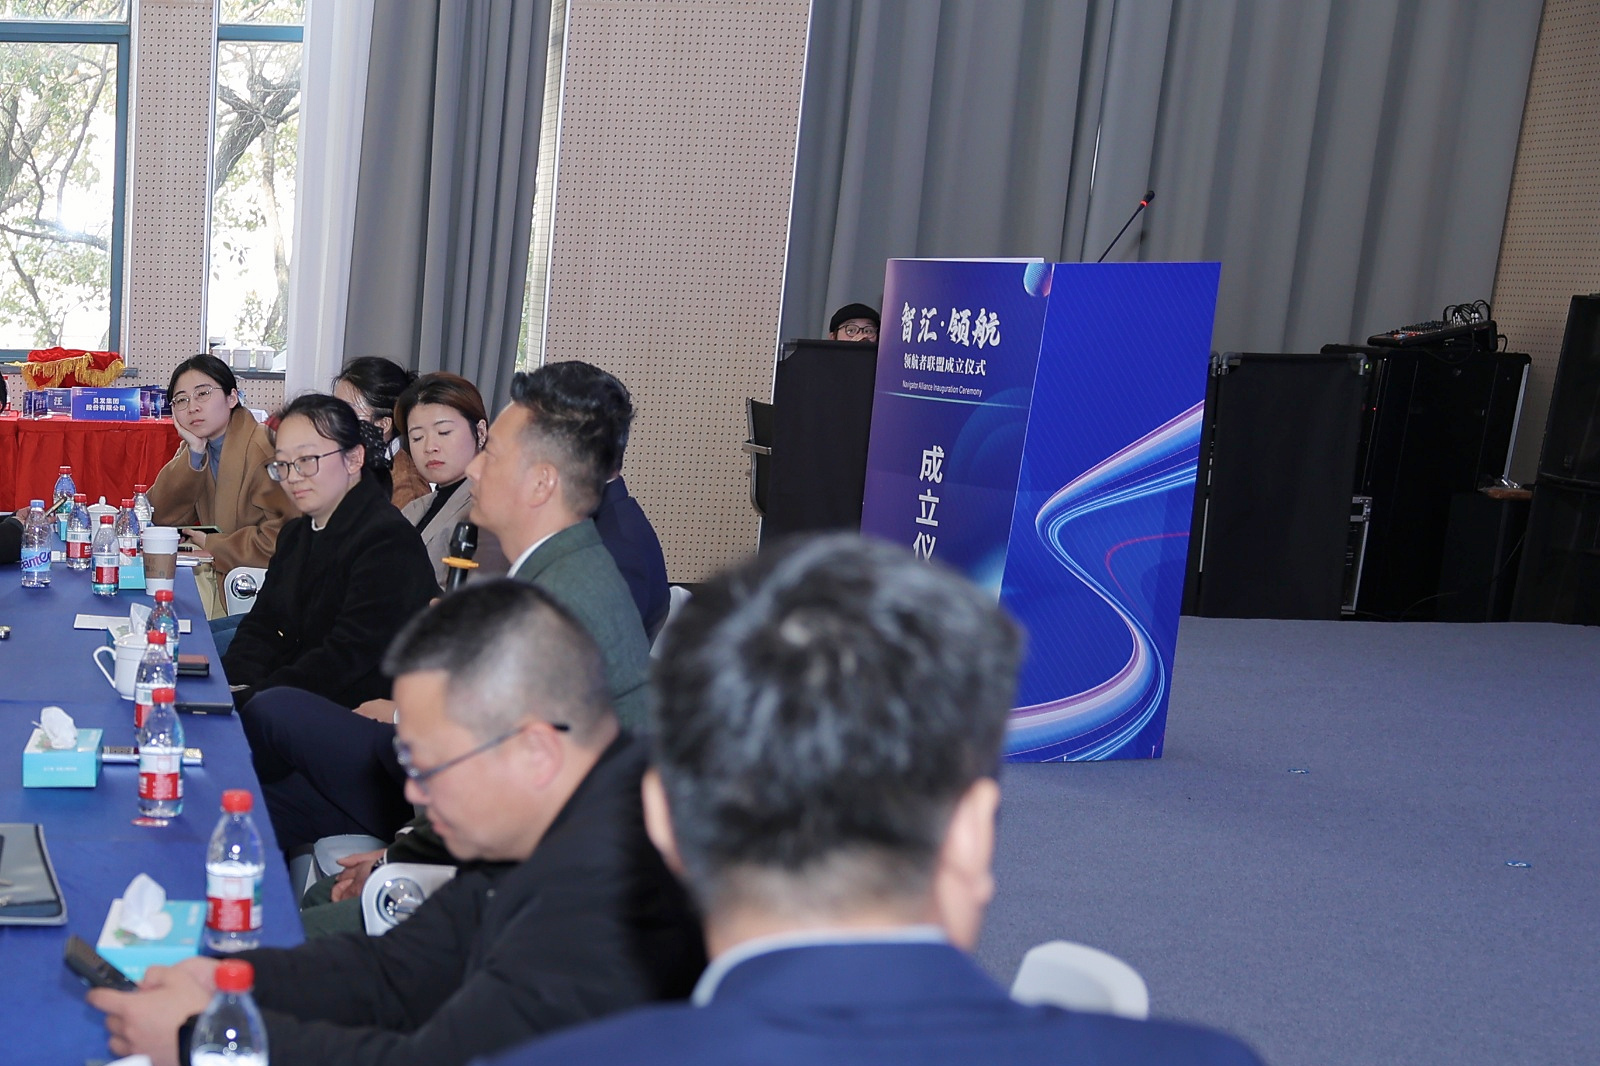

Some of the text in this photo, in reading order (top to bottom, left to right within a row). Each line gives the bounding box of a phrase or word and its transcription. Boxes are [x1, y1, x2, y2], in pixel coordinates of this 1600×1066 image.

[901, 301, 1000, 349] 智汇·领航
[904, 353, 986, 376] 领航者联盟成立仪式
[902, 380, 982, 397] Navigator Alliance Inauguration Ceremony
[85, 404, 126, 412] 股份有限公司
